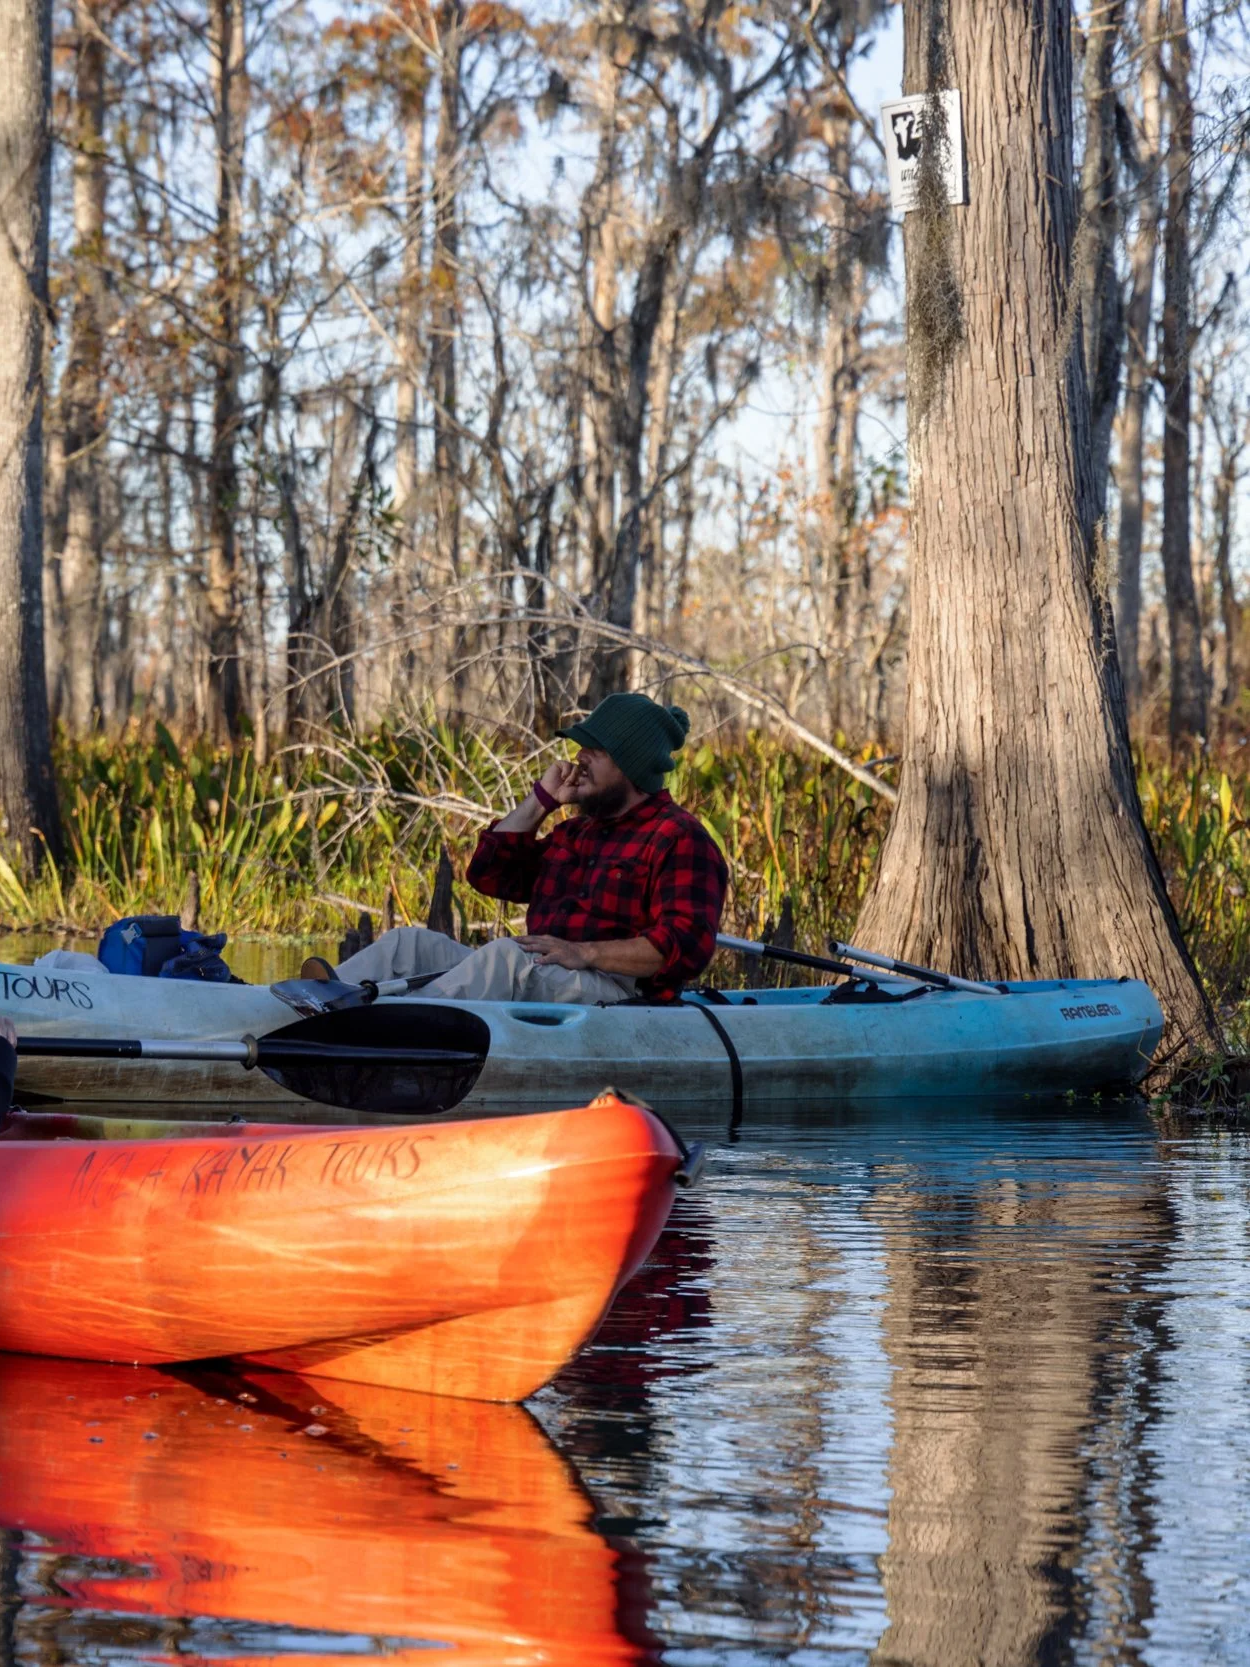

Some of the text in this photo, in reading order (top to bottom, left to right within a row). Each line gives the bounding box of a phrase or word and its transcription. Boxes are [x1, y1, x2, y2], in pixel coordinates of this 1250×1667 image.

[1060, 1004, 1113, 1021] RAMBLER
[180, 1143, 300, 1200] KAYAK
[318, 1136, 435, 1186] TOURS
